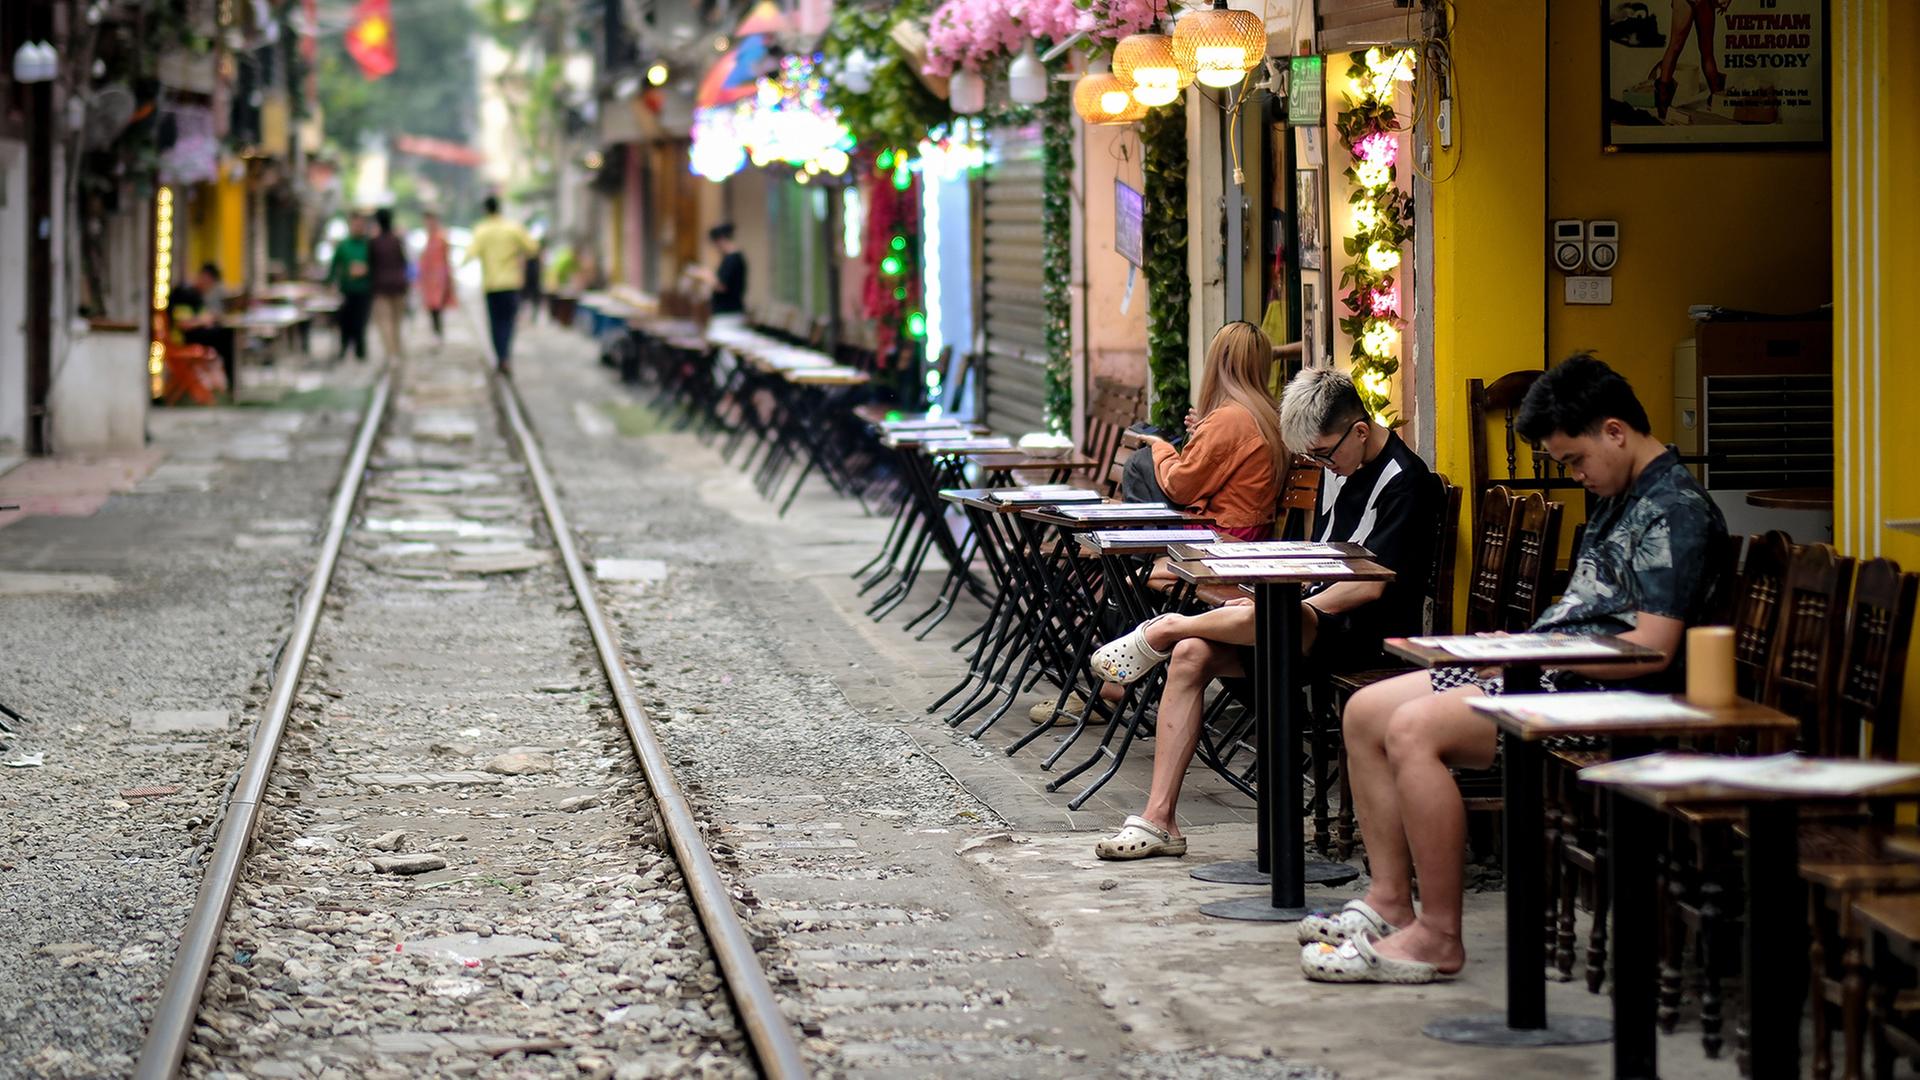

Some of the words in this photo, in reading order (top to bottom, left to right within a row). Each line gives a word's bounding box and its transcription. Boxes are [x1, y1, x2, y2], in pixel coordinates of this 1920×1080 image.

[1725, 14, 1811, 30] VIETNAM
[1725, 34, 1810, 49] RAILROAD
[1724, 54, 1810, 68] HISTORY
